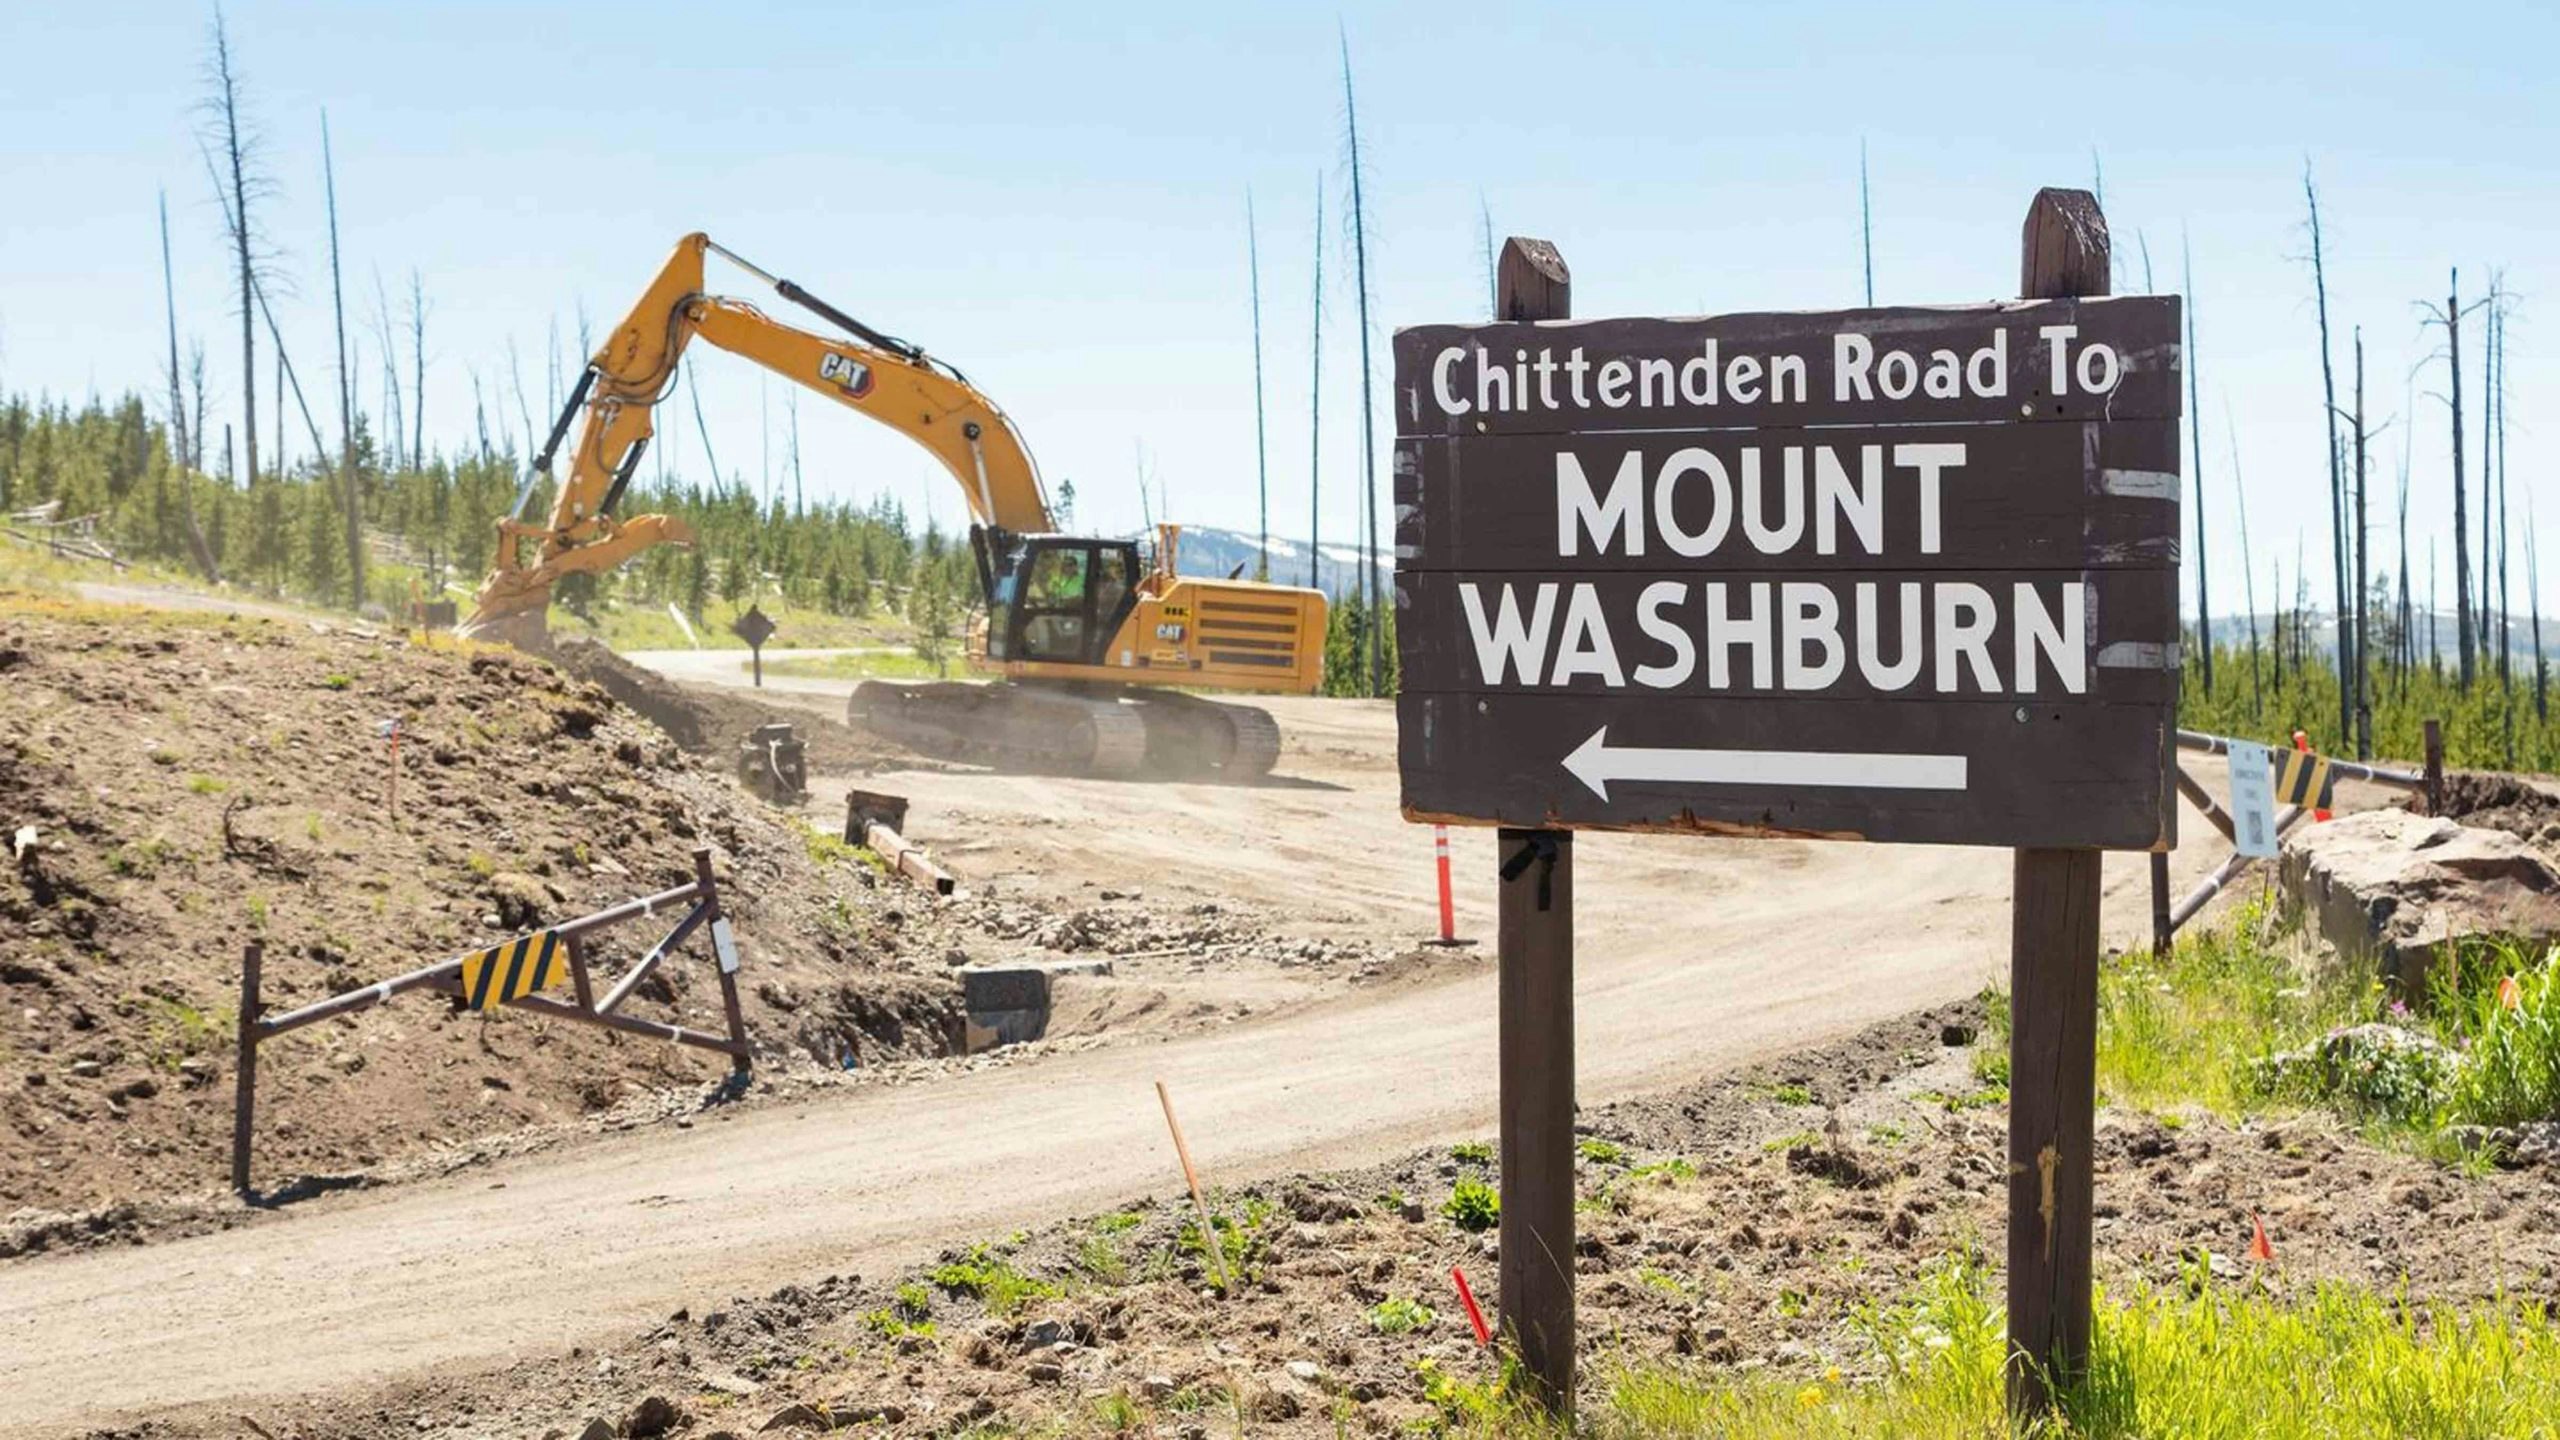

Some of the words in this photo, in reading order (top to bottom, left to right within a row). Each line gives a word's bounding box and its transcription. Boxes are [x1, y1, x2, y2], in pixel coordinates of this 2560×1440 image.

[820, 353, 867, 388] CAT
[1432, 338, 1807, 415] Chittenden
[1834, 327, 2007, 402] Road
[2039, 325, 2119, 395] To
[1556, 443, 1966, 557] MOUNT
[1156, 623, 1182, 640] CAT
[1458, 582, 2087, 694] WASHBURN
